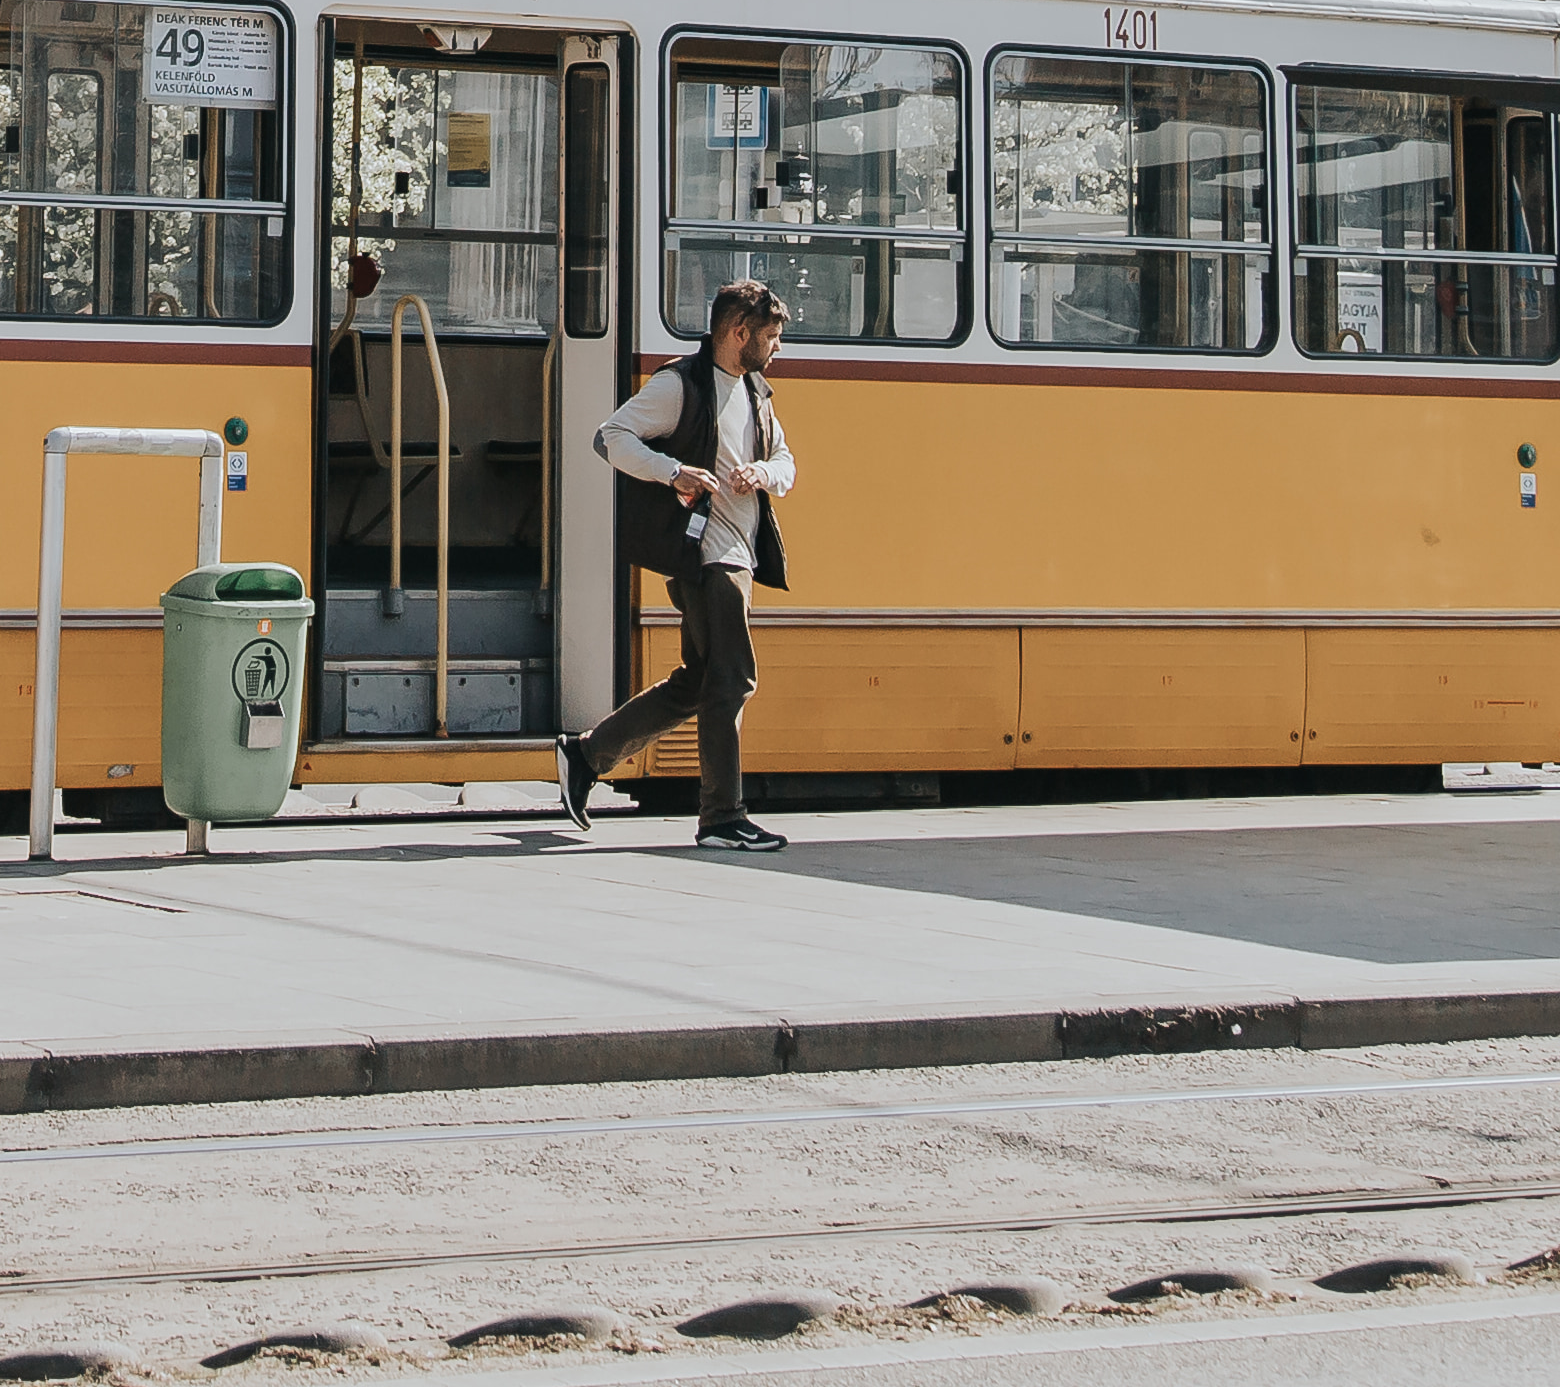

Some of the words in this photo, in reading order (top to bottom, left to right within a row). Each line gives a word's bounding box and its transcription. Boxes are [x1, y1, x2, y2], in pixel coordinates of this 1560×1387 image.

[156, 12, 184, 25] DEÁK
[188, 15, 228, 28] FERENC
[230, 16, 250, 29] TÉR
[253, 19, 264, 29] M
[1104, 7, 1157, 51] 1401
[155, 28, 205, 67] 49
[155, 70, 216, 83] KELENFÖLD
[155, 82, 239, 97] VASÚTÁLLOMÁS
[242, 87, 253, 97] M
